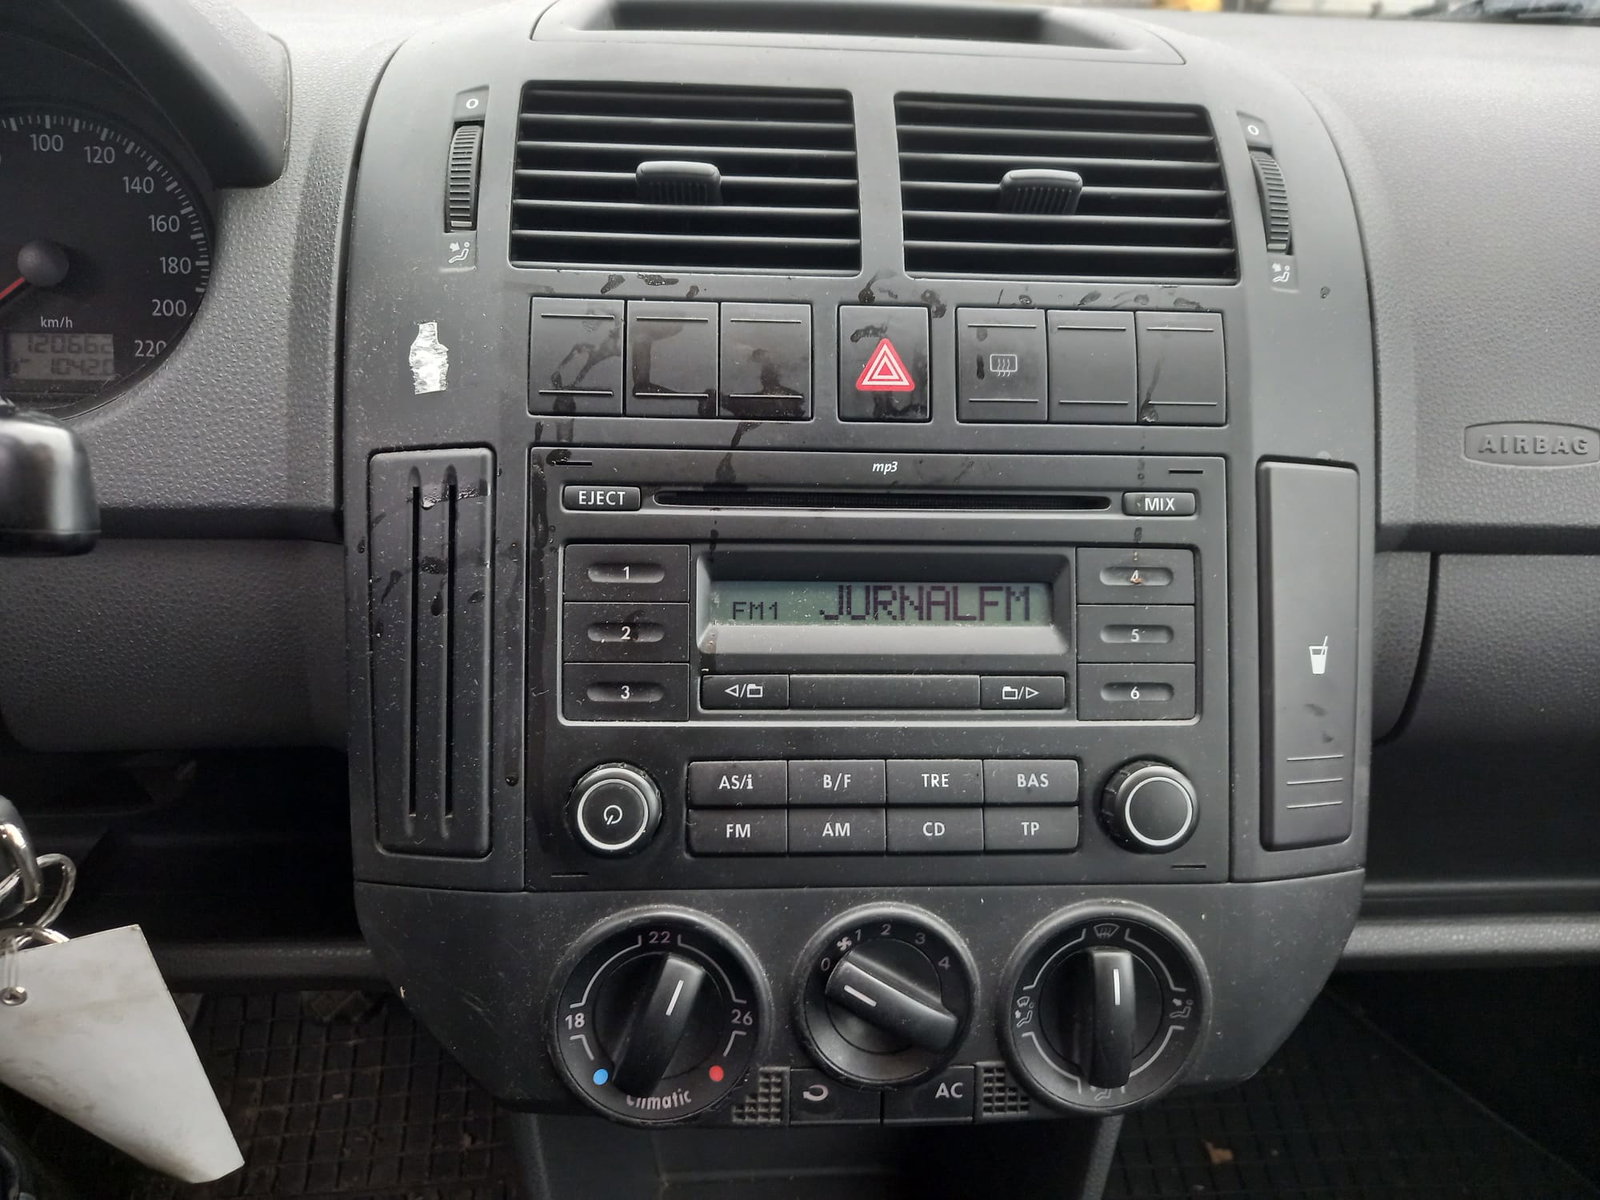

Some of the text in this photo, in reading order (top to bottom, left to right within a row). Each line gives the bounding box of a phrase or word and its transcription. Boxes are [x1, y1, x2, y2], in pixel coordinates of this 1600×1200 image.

[29, 133, 64, 152] 100
[84, 146, 115, 164] 120
[123, 176, 154, 194] 140
[148, 215, 180, 232] 160
[160, 256, 192, 274] 180
[152, 299, 187, 317] 200
[40, 315, 73, 328] km/h
[1478, 434, 1588, 456] AIRBAG
[872, 461, 898, 475] mp3
[578, 490, 626, 506] EJECT
[1144, 497, 1175, 511] MIX
[622, 566, 630, 580] 1
[732, 601, 779, 621] FM1
[819, 585, 1031, 622] JURNALFM
[621, 626, 631, 640] 2
[1130, 629, 1140, 642] 5
[620, 685, 631, 700] 3
[1130, 687, 1140, 700] 6
[823, 773, 852, 791] B/F
[921, 773, 950, 788] TRE
[1017, 773, 1049, 788] BAS
[726, 823, 751, 839] FM
[822, 822, 851, 838] AM
[922, 821, 946, 837] CD
[1021, 821, 1040, 836] TP
[855, 929, 863, 941] 1
[880, 923, 892, 936] 2
[648, 931, 671, 944] 22
[914, 932, 926, 945] 3
[821, 957, 831, 971] 0
[937, 956, 950, 970] 4
[564, 1012, 586, 1030] 18
[731, 1008, 753, 1026] 26
[934, 1082, 964, 1099] AC
